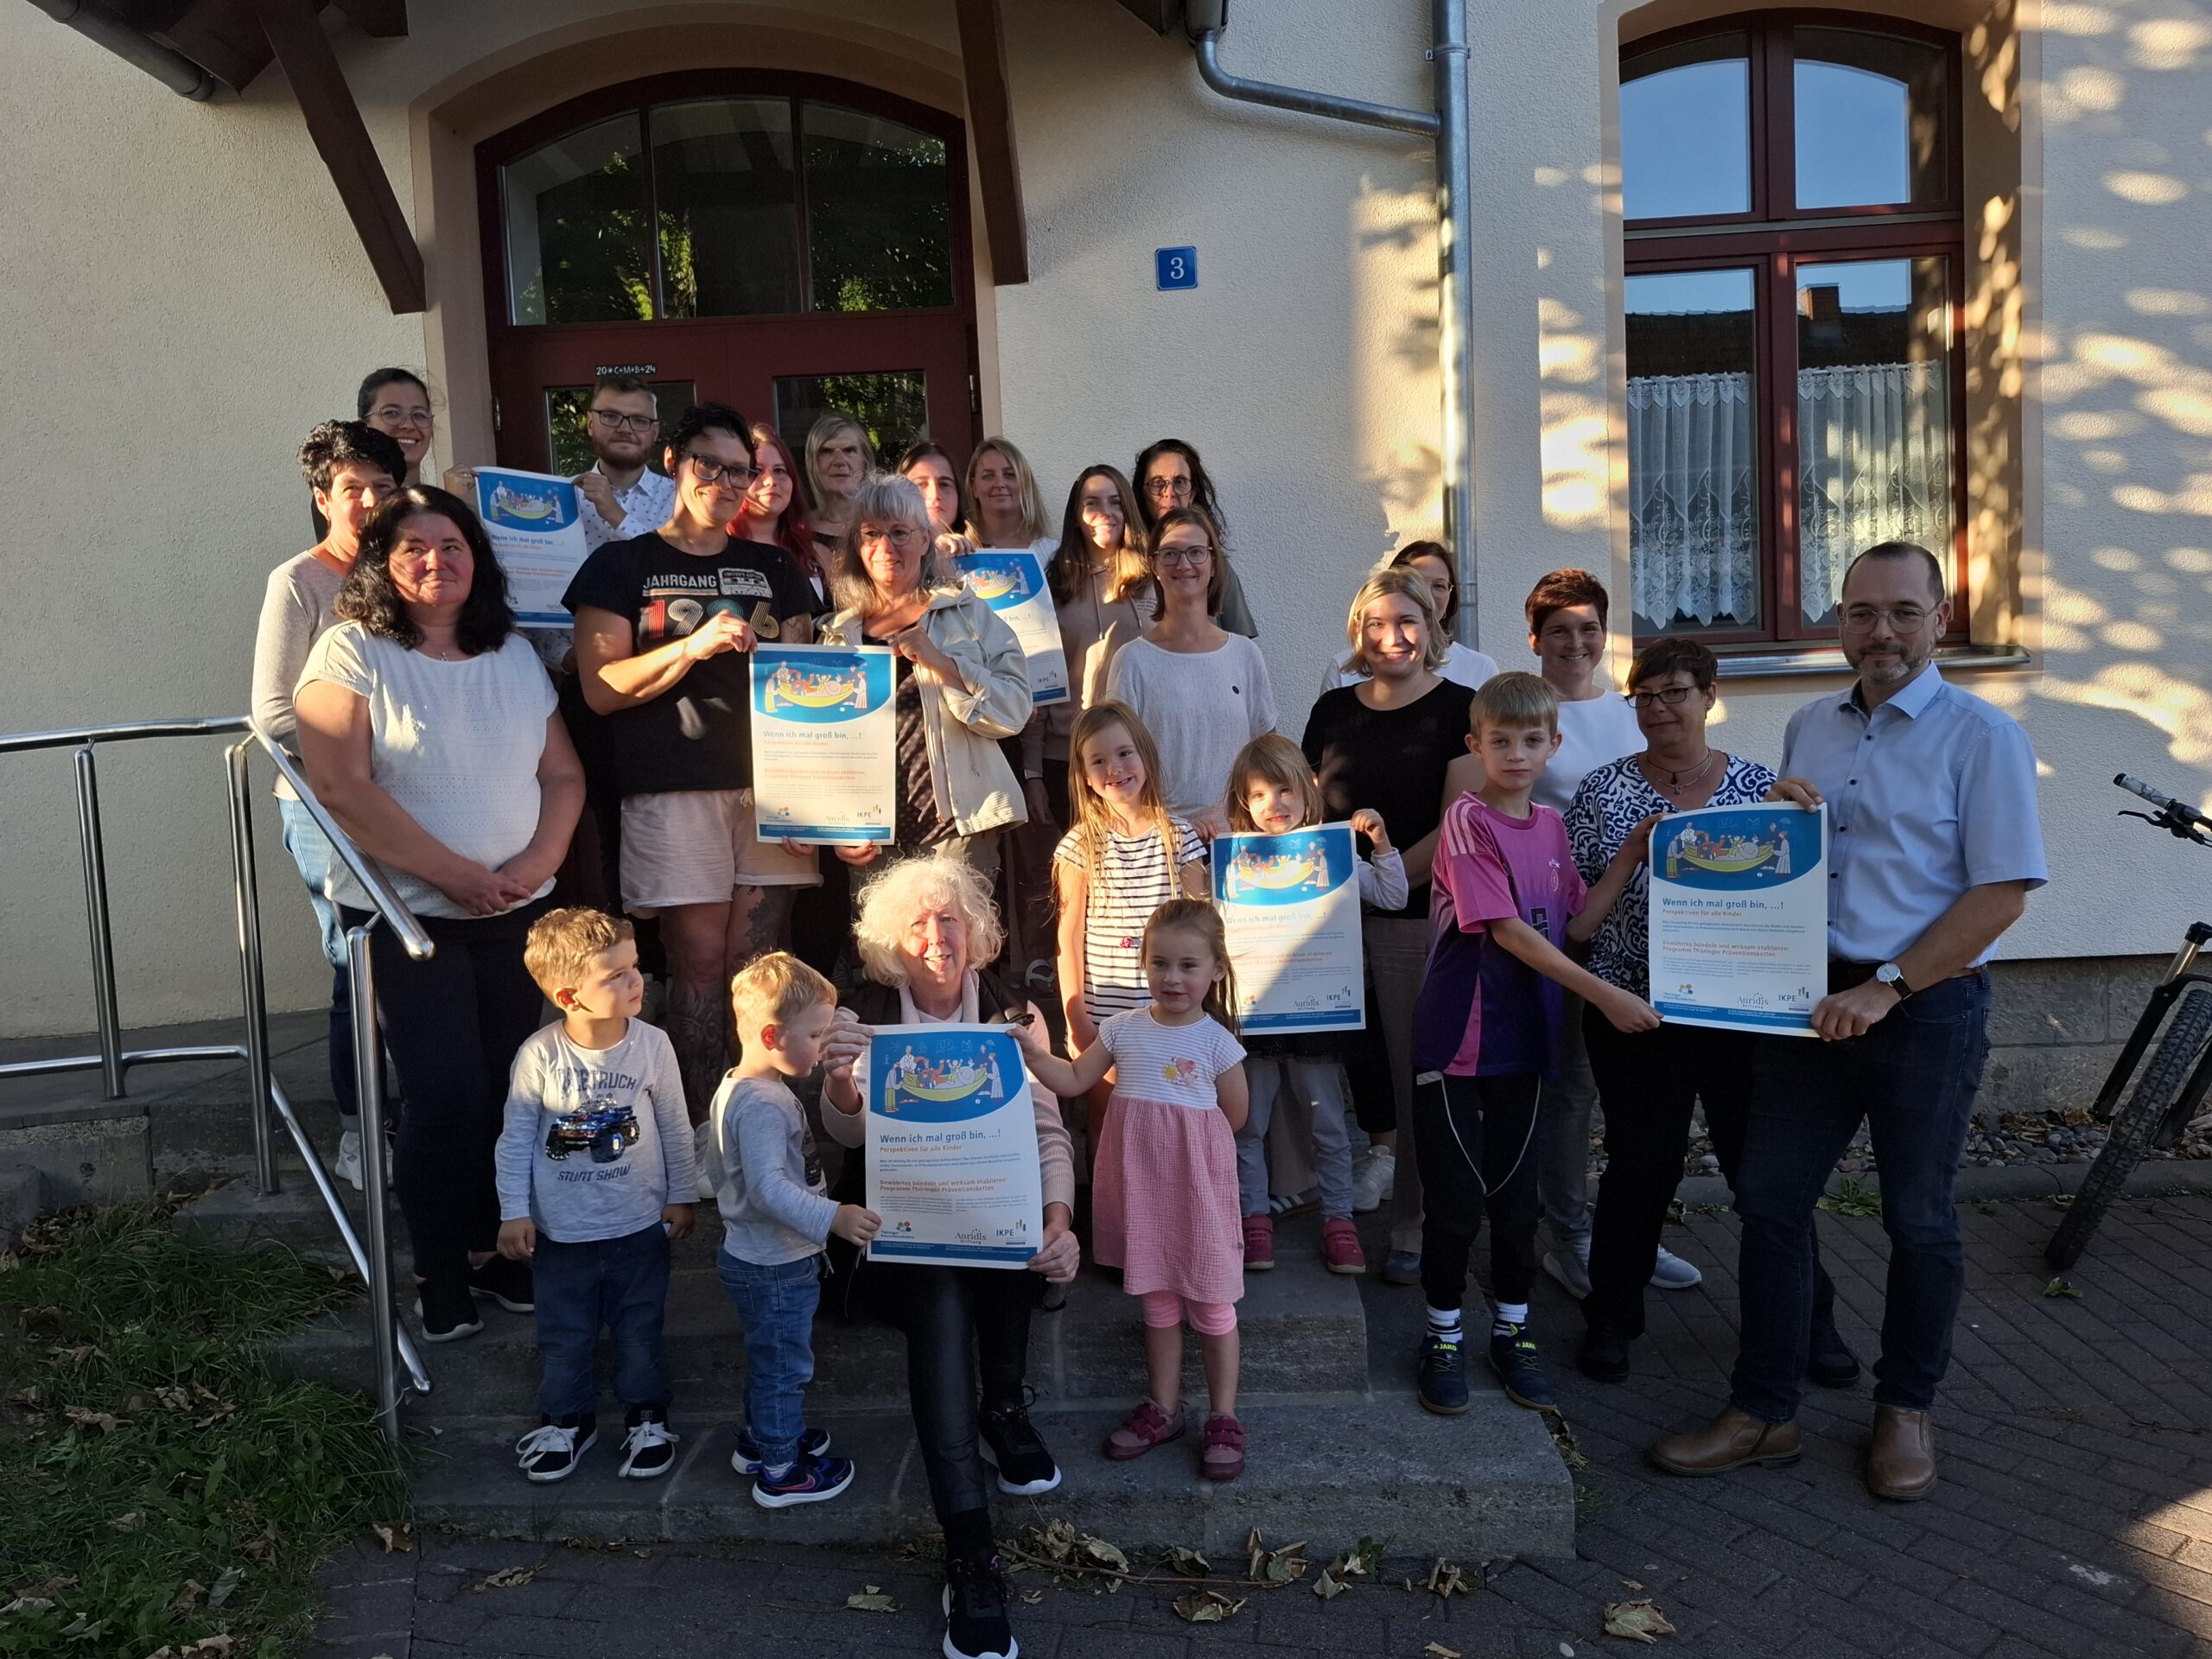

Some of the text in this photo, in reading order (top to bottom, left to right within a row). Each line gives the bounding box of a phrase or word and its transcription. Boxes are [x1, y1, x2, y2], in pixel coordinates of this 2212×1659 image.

[1171, 257, 1184, 279] 3
[643, 574, 717, 588] JAHRGANG
[815, 731, 832, 740] groß
[1726, 899, 1747, 910] groß
[1750, 900, 1767, 910] bin,
[1262, 914, 1276, 923] mal
[1293, 999, 1319, 1007] Auridis
[1737, 996, 1769, 1005] Auridis
[589, 1070, 637, 1090] TRUCK
[880, 1135, 906, 1143] Wenn
[909, 1134, 923, 1142] ich
[925, 1133, 943, 1142] mal
[945, 1131, 966, 1143] groß
[969, 1130, 986, 1141] bin,
[557, 1164, 631, 1182] STUNT SHOW
[955, 1232, 987, 1241] Auridis
